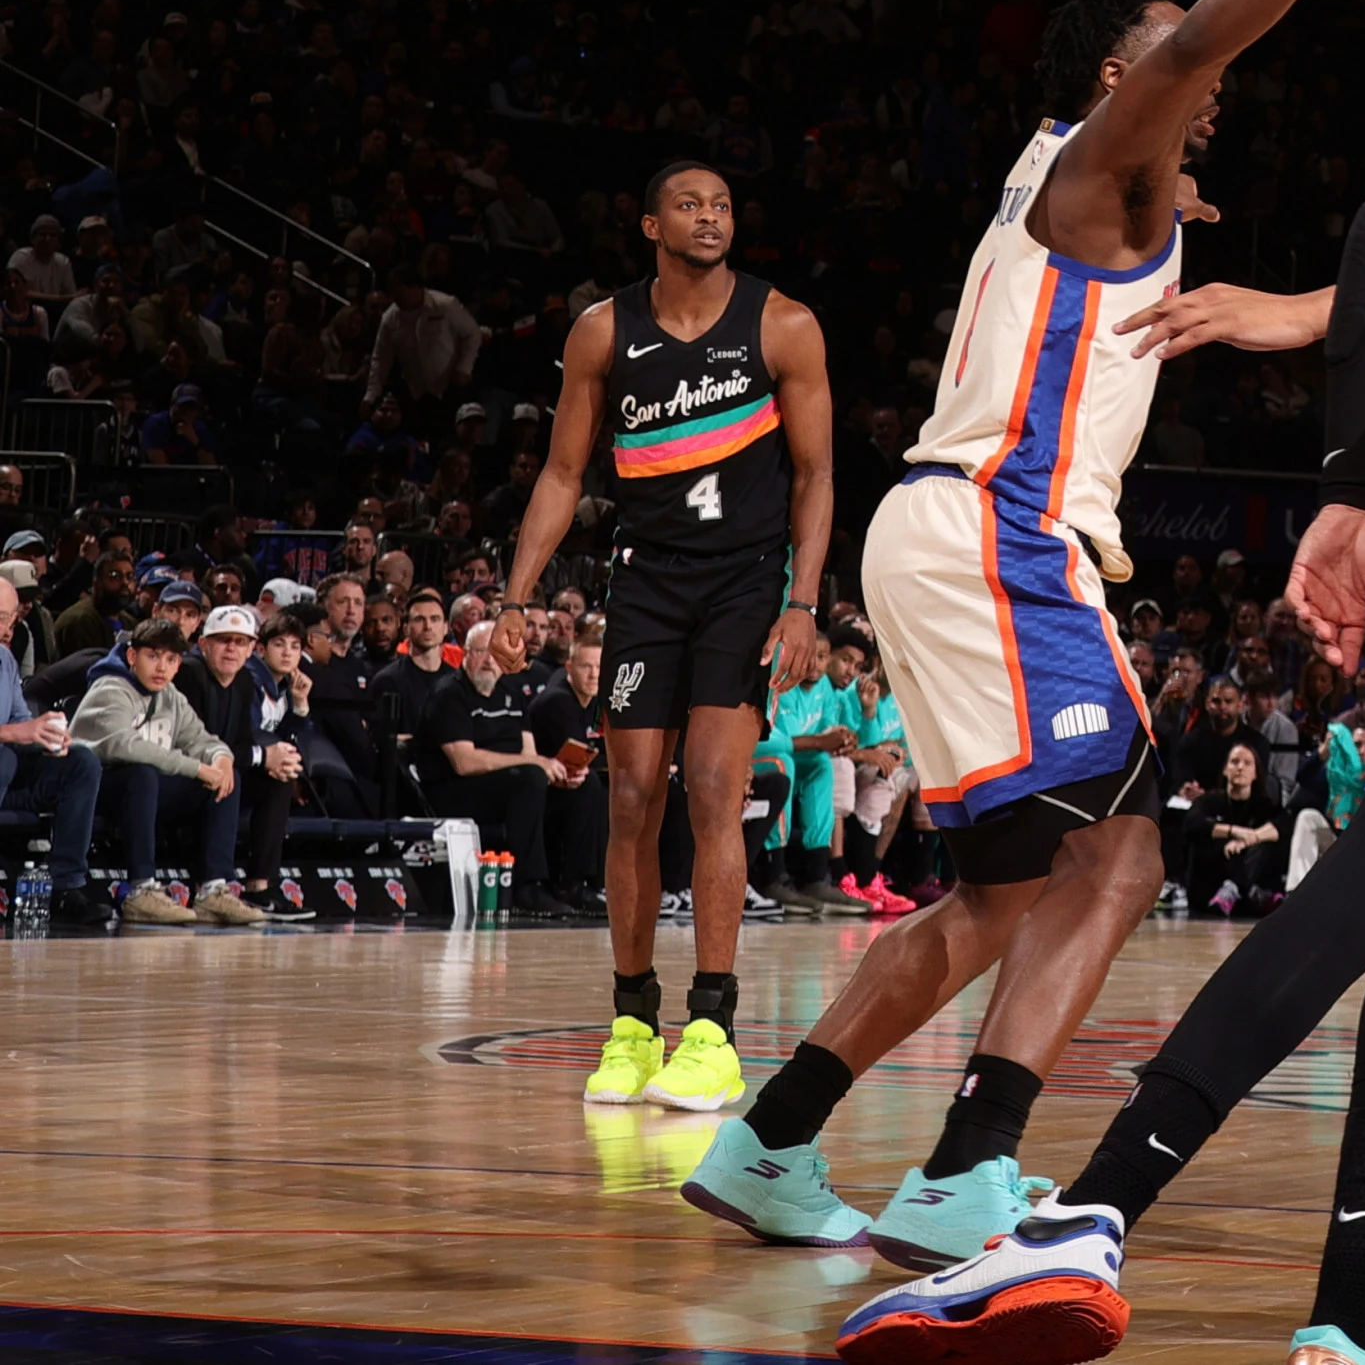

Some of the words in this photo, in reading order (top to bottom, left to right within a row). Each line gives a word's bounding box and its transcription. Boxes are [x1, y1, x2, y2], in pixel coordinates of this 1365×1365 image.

[712, 350, 742, 360] LEDGER
[621, 394, 661, 430] San
[664, 369, 752, 417] Antonio
[685, 471, 723, 521] 4
